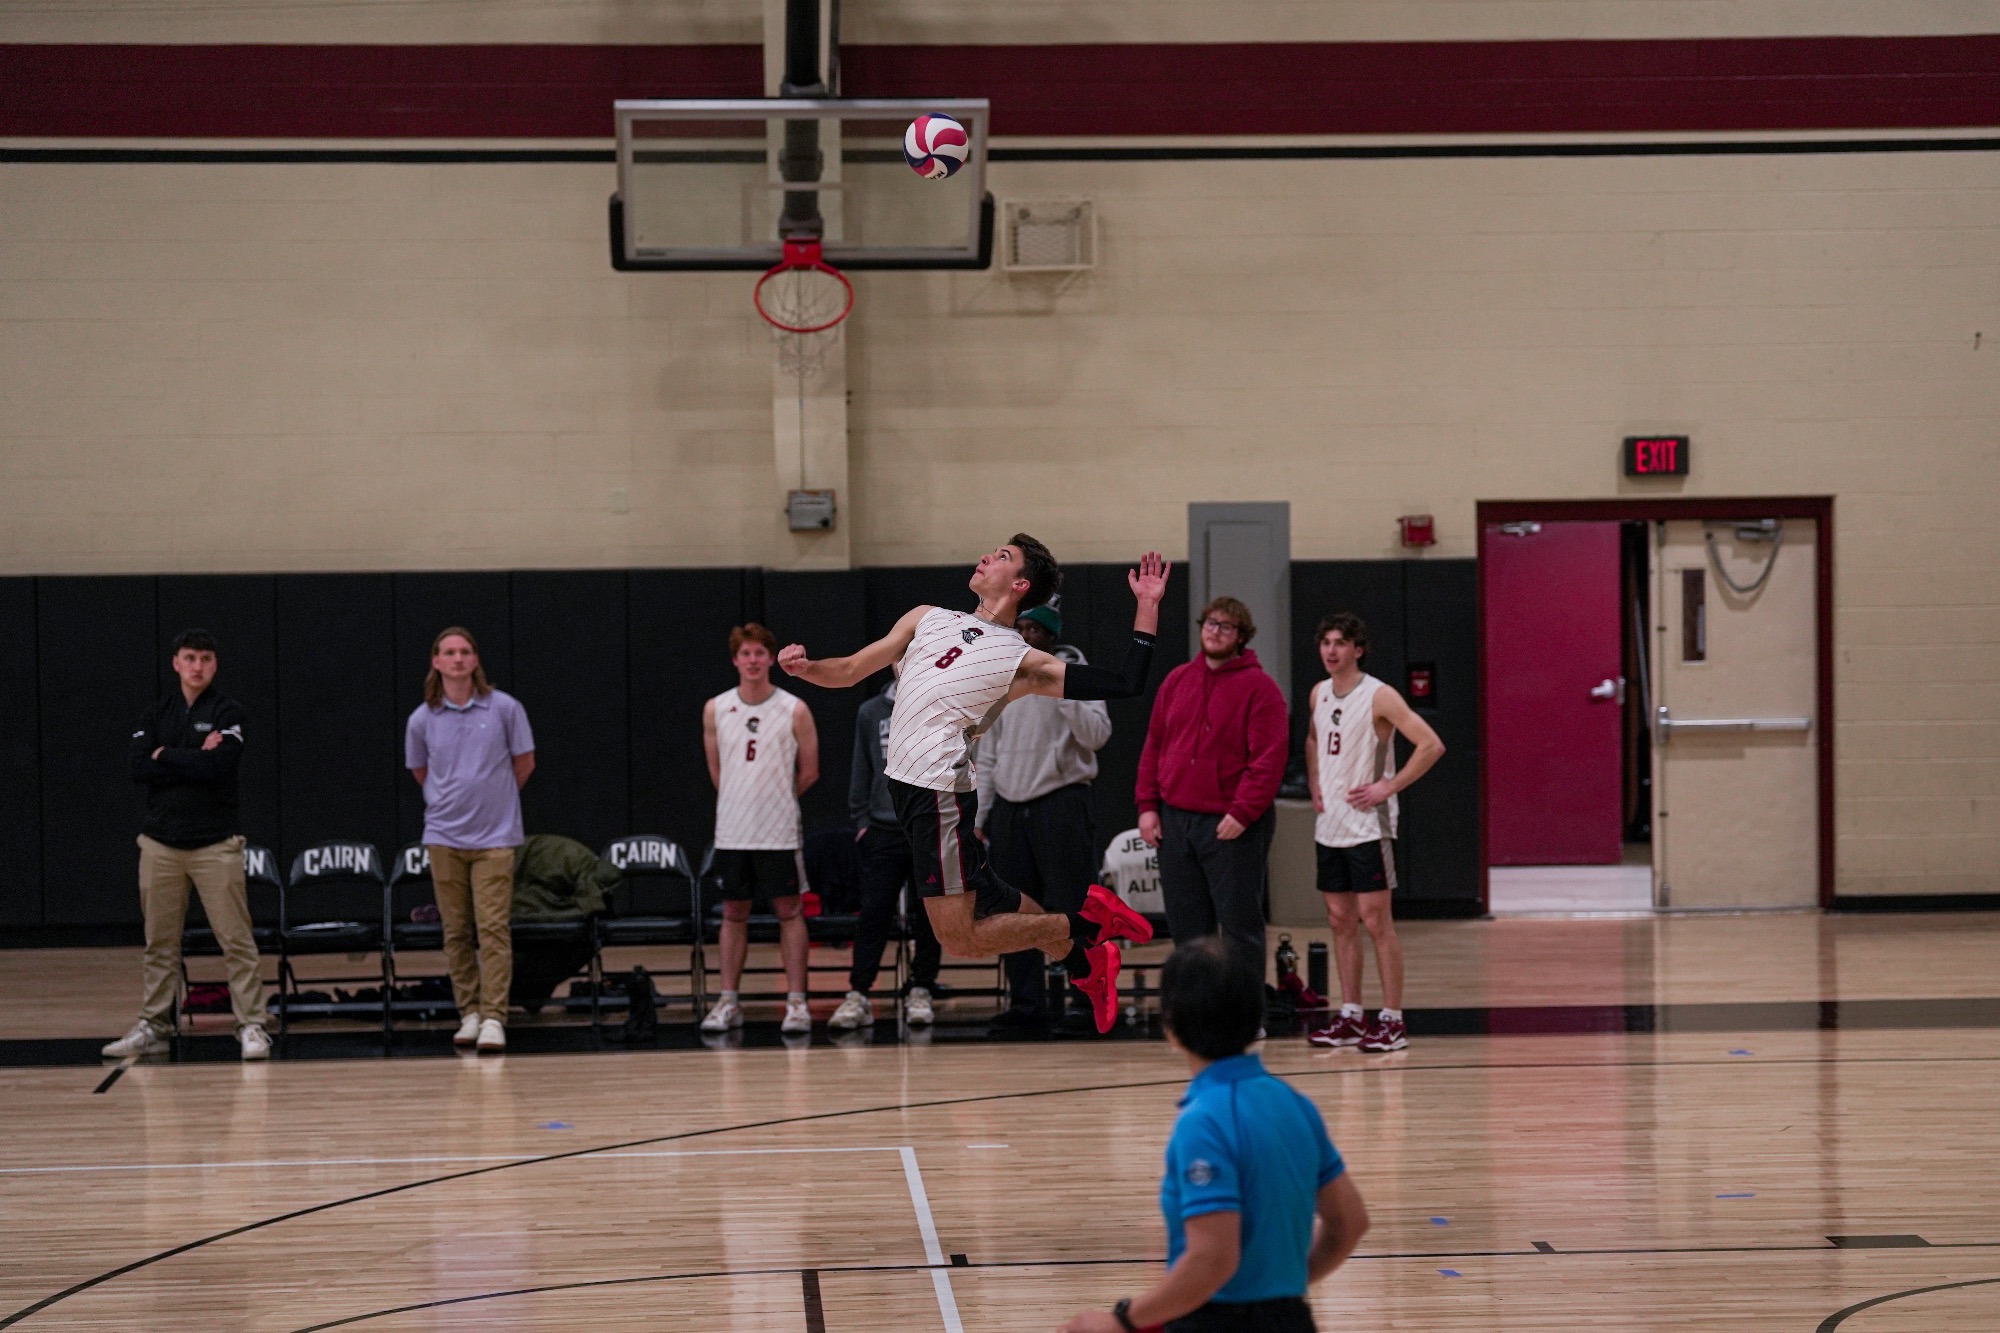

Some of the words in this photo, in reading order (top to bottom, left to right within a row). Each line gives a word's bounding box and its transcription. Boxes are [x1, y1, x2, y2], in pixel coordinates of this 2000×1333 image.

[1636, 440, 1678, 473] EXIT
[935, 646, 963, 670] 8
[746, 739, 757, 762] 6
[1327, 731, 1341, 756] 13
[303, 845, 370, 876] CAIRN
[405, 847, 431, 875] CA
[611, 840, 678, 870] CAIRN
[1127, 878, 1161, 894] ALI
